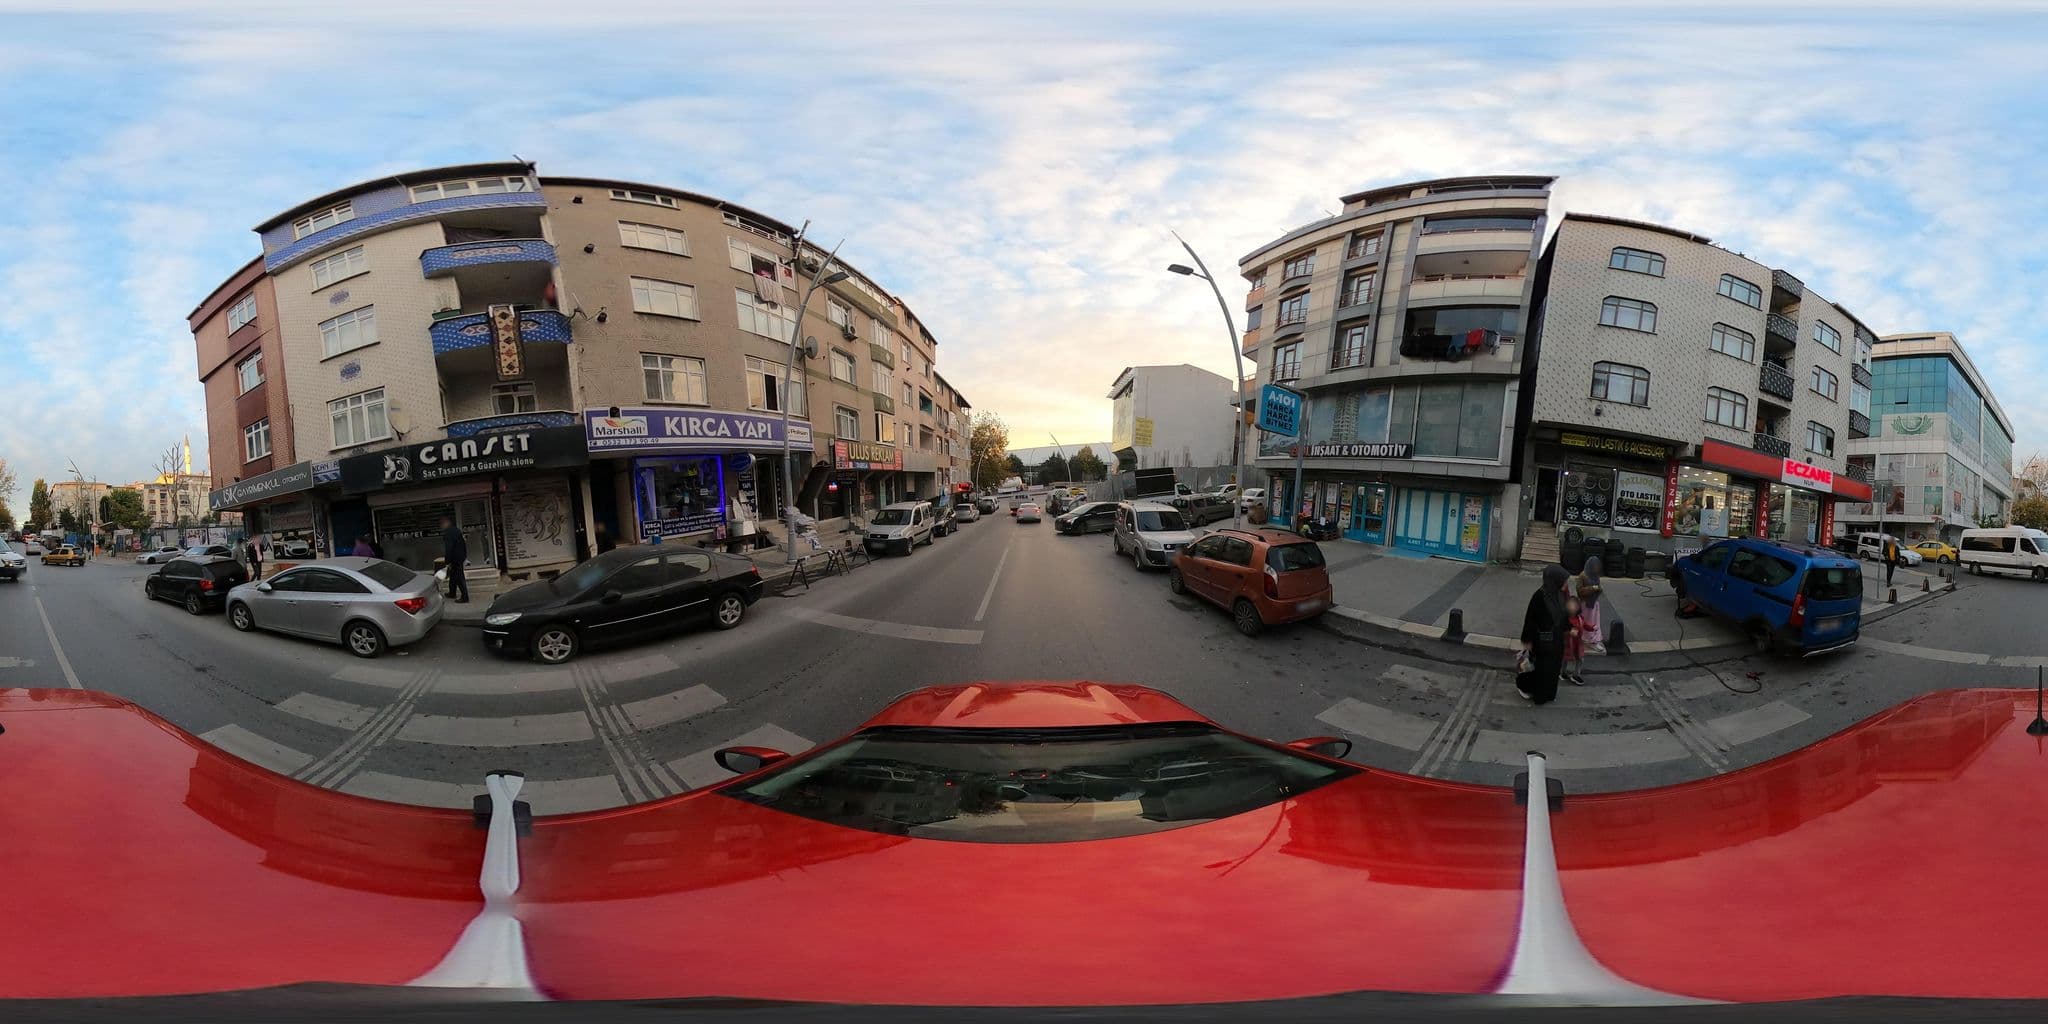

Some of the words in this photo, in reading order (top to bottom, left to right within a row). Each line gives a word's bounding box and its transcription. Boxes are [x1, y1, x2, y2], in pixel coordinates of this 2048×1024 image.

[1268, 400, 1293, 415] HARCA
[1267, 409, 1293, 422] HARCA
[595, 426, 642, 436] Marshall
[664, 416, 731, 437] KIRCA
[735, 420, 772, 439] YAPI
[420, 434, 530, 464] CANSET
[849, 443, 870, 460] ULUS
[871, 447, 895, 465] REKLAM
[1342, 446, 1349, 455] &
[1351, 443, 1407, 457] OTOMOTİV
[423, 469, 436, 478] Saç
[470, 463, 476, 471] &
[1785, 460, 1832, 485] ECZANE
[1620, 490, 1635, 498] OTO
[1666, 466, 1677, 530] ECZANE
